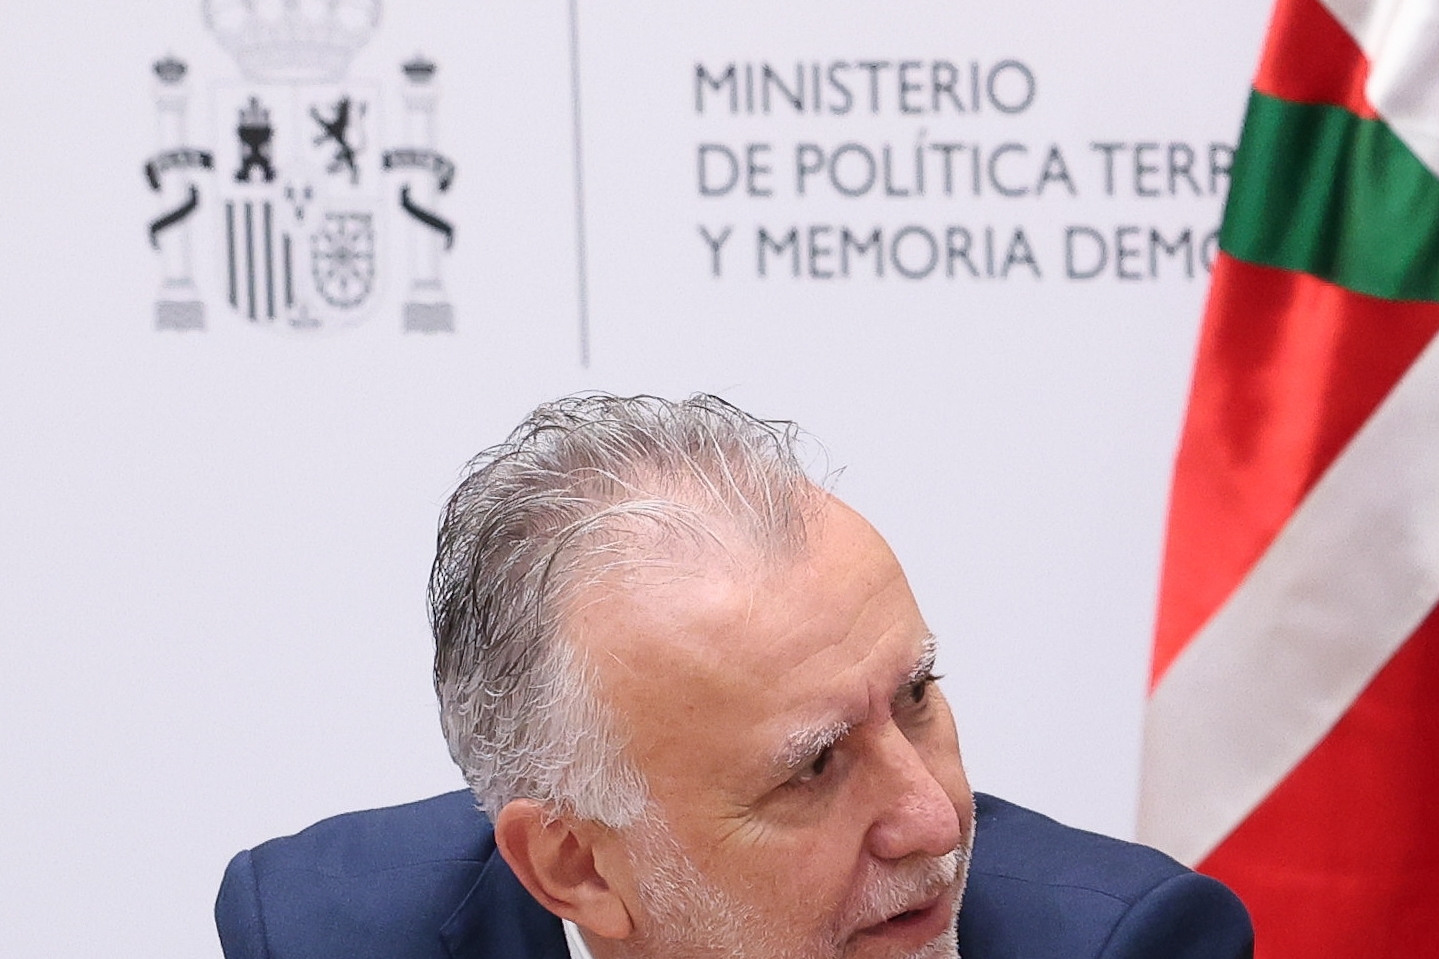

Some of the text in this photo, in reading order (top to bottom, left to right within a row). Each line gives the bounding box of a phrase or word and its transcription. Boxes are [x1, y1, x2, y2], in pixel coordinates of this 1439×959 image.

[693, 59, 1037, 115] MINISTERIO
[697, 142, 773, 198] DE
[795, 127, 1078, 198] POLÍTICA
[697, 225, 733, 278] Y
[756, 225, 1042, 279] MEMORIA
